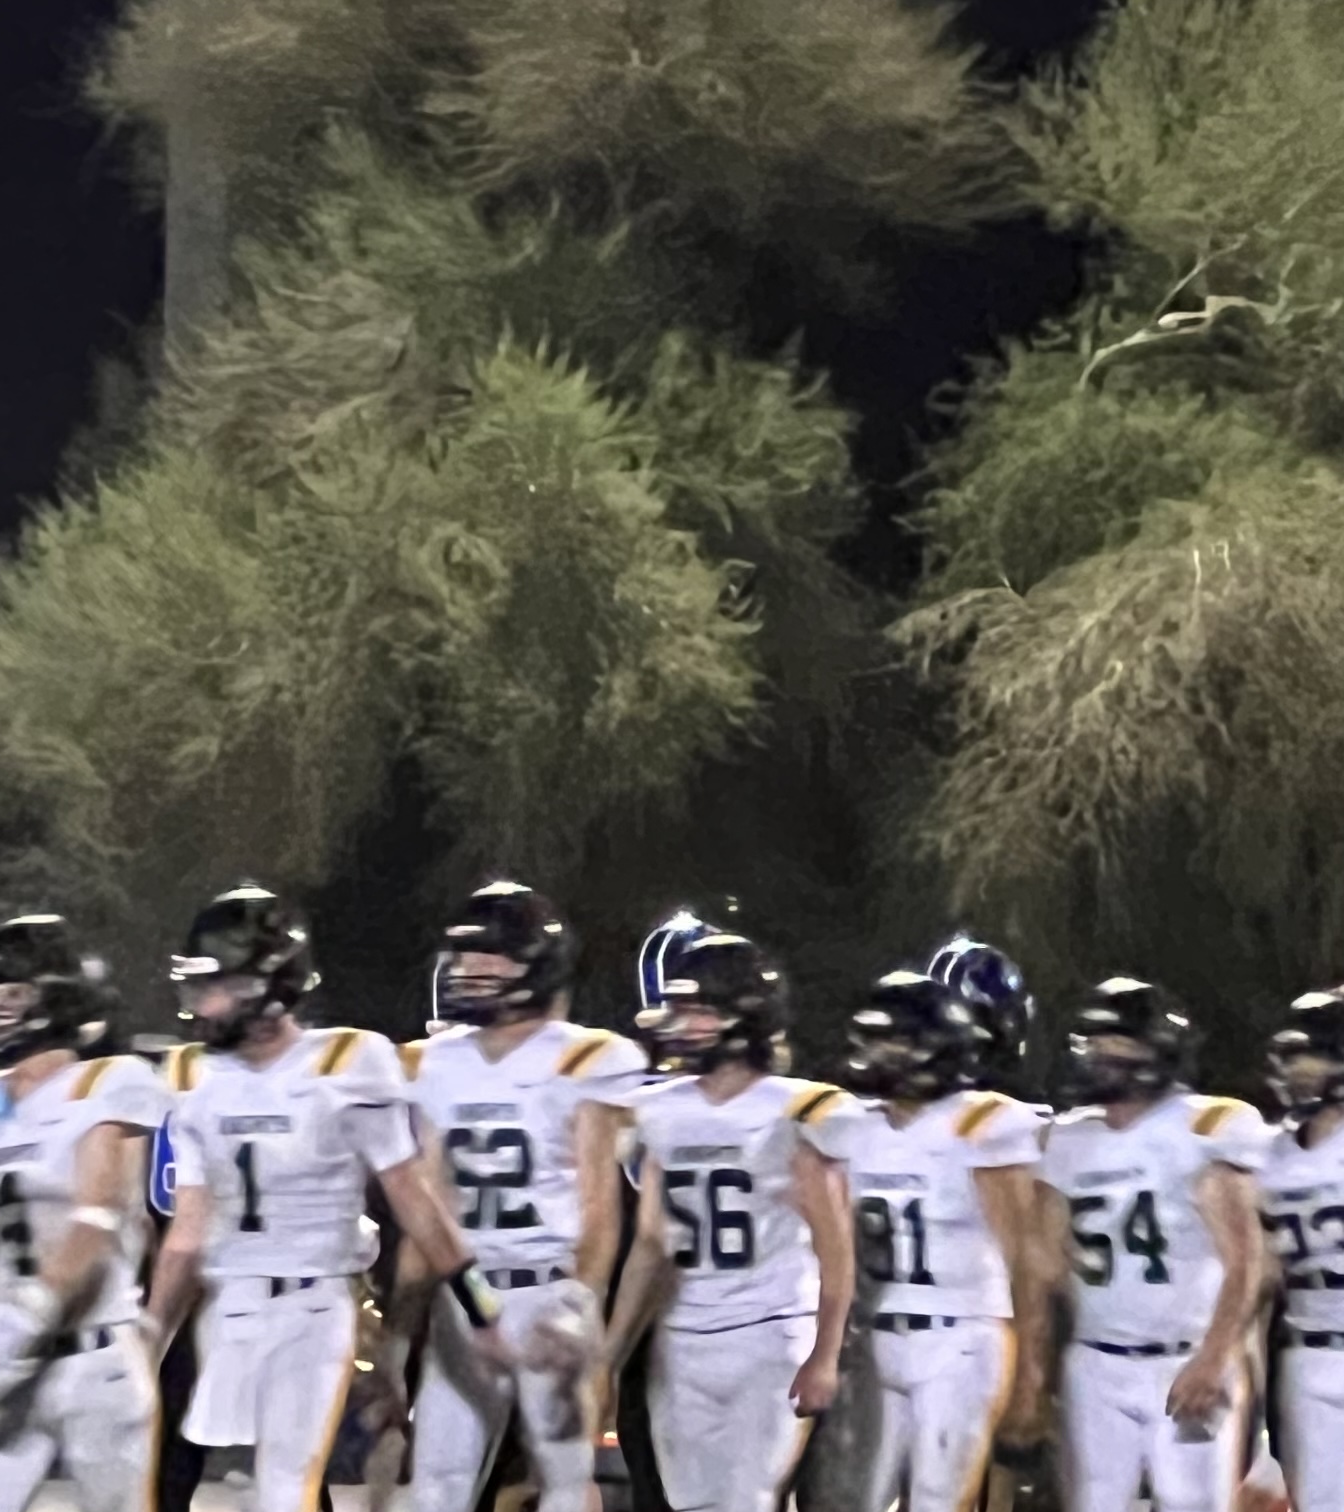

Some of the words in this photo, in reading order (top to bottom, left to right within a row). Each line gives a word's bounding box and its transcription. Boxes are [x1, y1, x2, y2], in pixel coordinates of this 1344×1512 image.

[234, 1141, 267, 1232] 1
[662, 1168, 755, 1270] 56
[1069, 1190, 1171, 1287] 54
